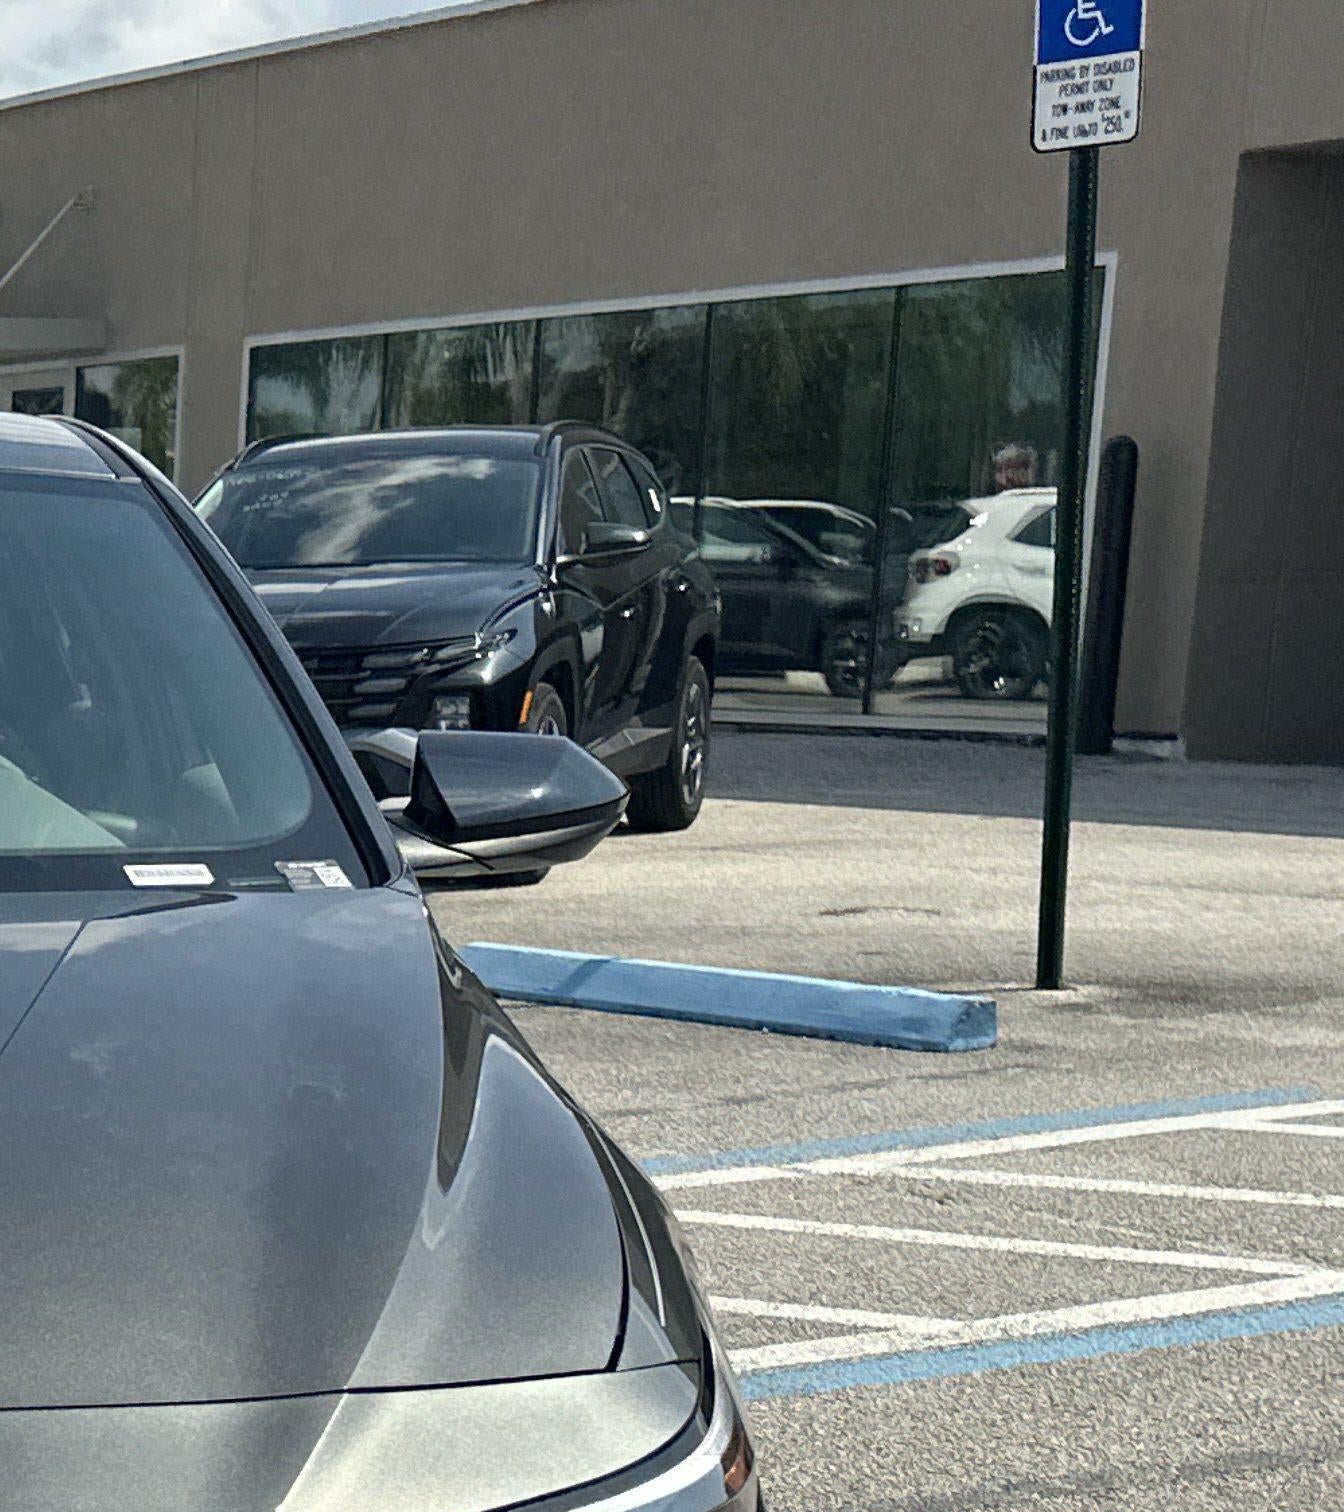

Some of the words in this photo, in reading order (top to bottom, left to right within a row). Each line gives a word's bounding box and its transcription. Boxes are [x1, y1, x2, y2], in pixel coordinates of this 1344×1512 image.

[1093, 58, 1135, 76] DISABLED
[1059, 81, 1090, 97] PERMIT
[1093, 78, 1114, 93] ONLY
[1099, 96, 1121, 112] ZONE
